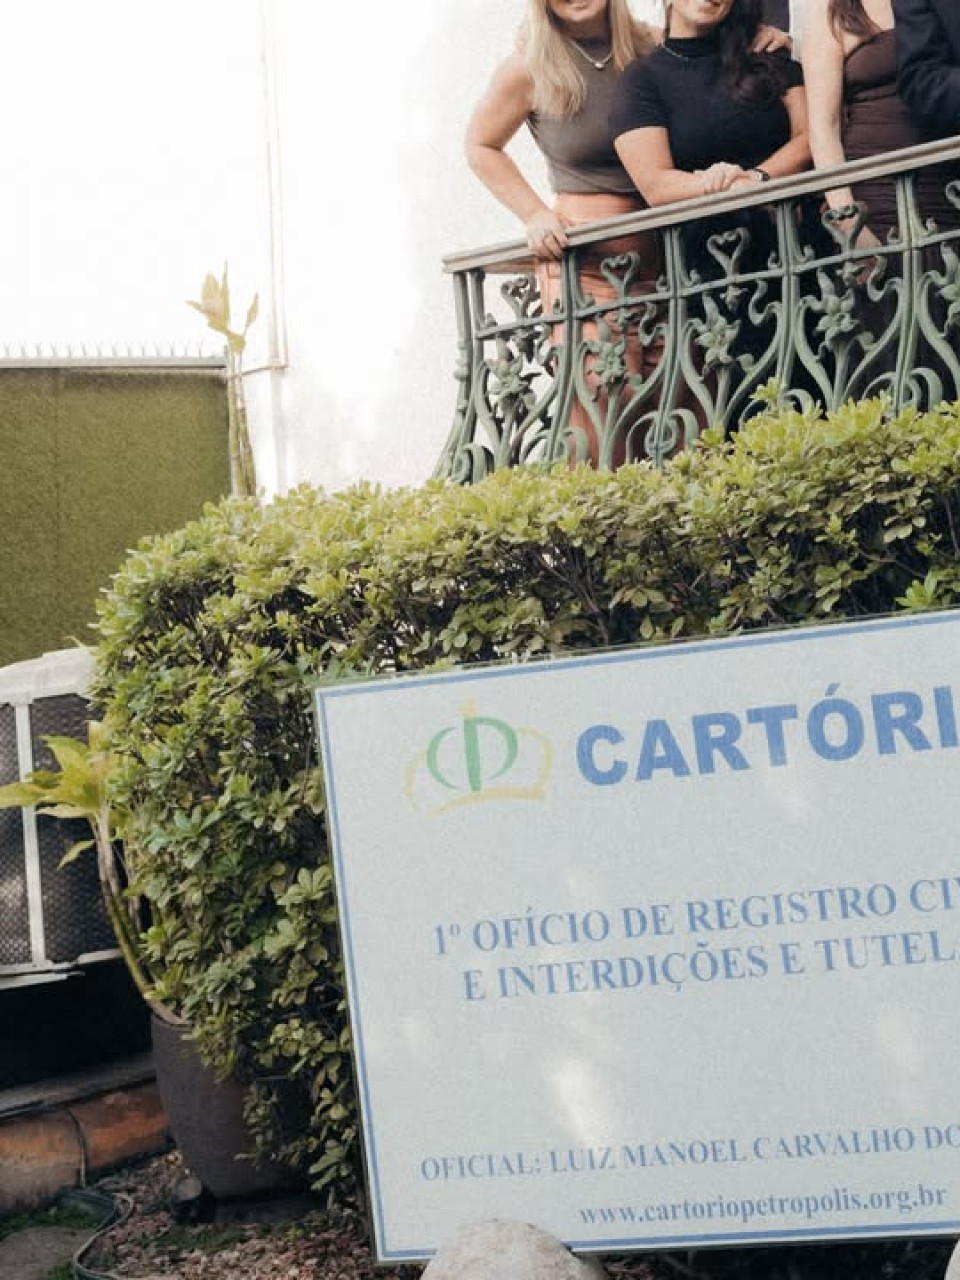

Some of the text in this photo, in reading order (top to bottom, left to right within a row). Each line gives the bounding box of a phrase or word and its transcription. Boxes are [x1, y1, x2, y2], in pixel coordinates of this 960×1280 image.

[434, 923, 461, 955] 1º
[472, 905, 610, 952] OFÍCIO
[621, 904, 675, 939] DE
[685, 883, 897, 933] REGISTRO
[463, 969, 486, 1001] E
[497, 942, 769, 998] INTERDIÇÕES
[779, 941, 806, 975] E
[421, 1151, 541, 1181] OFICIAL:
[549, 1145, 617, 1172] LUIZ
[623, 1138, 748, 1168] MANOEL
[752, 1126, 916, 1160] CARVALHO
[579, 1183, 948, 1223] www.cartoriopetropolis.org.br
